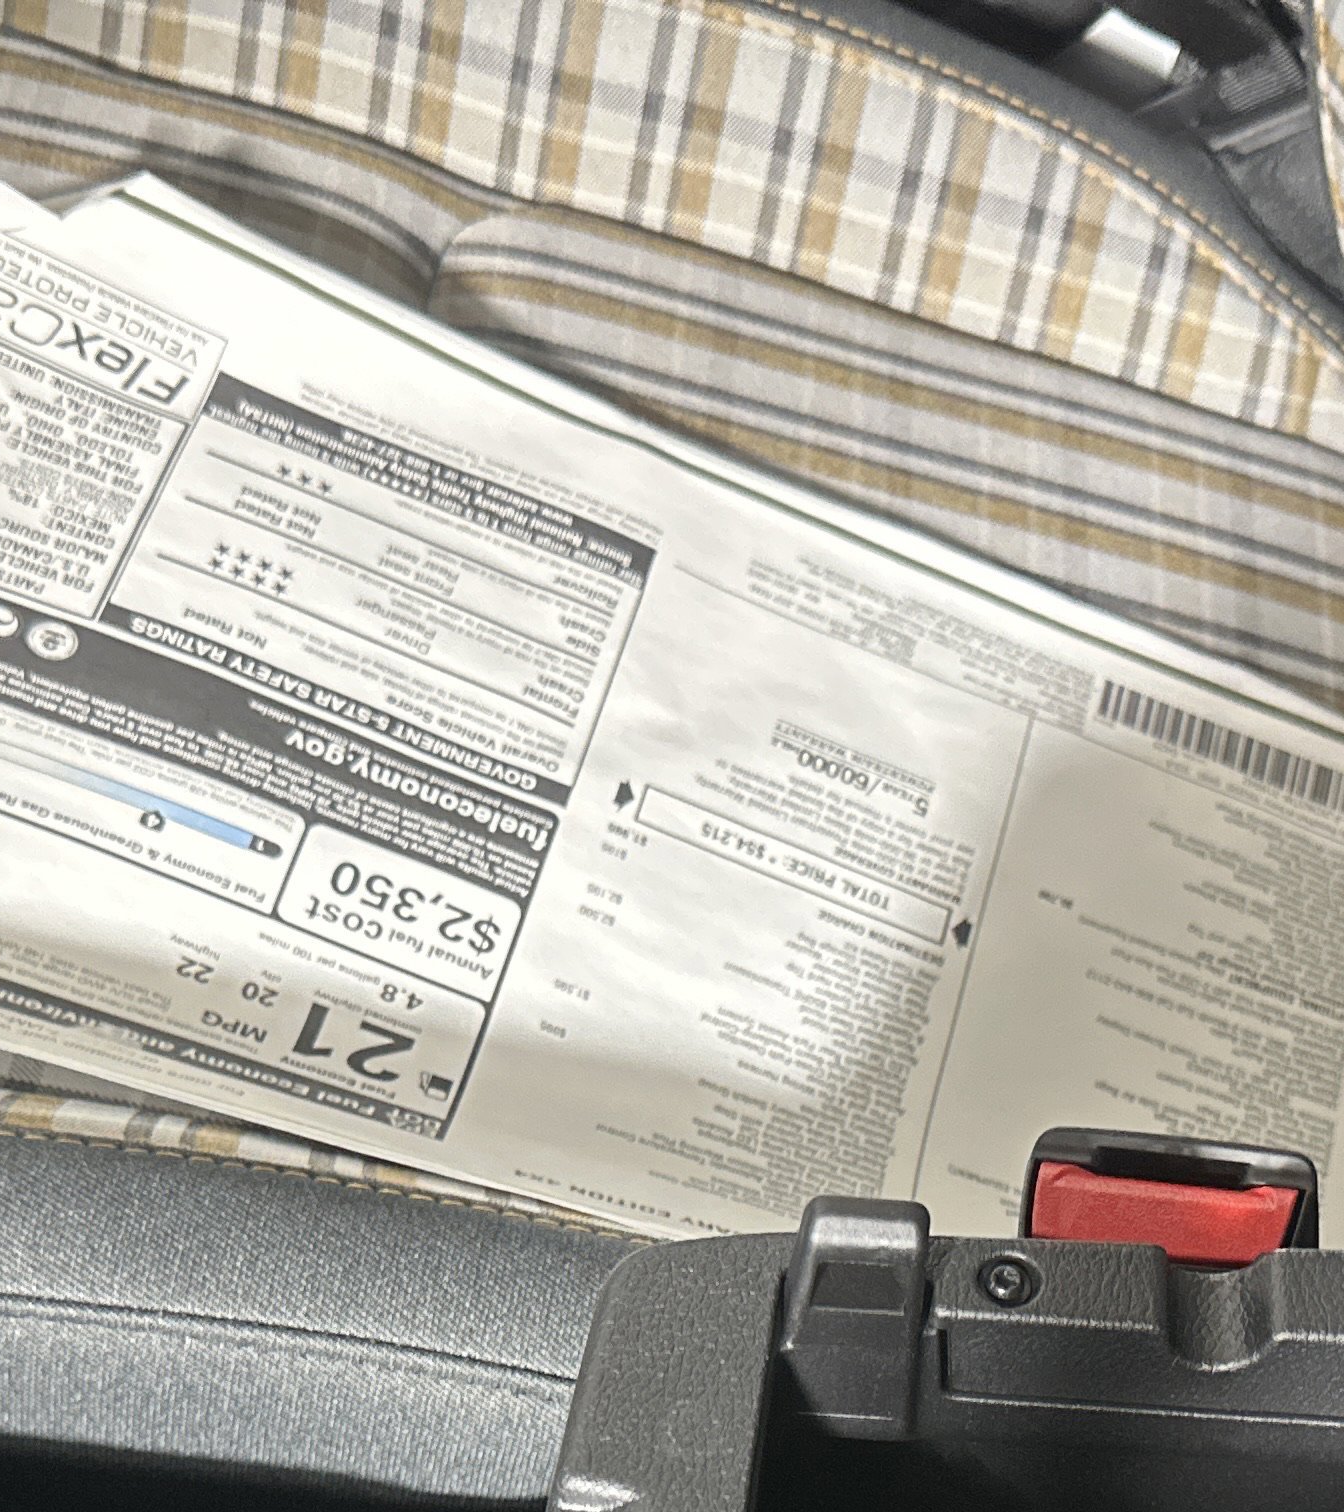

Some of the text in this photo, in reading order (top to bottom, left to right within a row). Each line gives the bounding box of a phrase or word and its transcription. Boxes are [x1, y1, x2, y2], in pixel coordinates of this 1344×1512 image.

[94, 304, 197, 364] VEHICLE
[54, 394, 97, 418] ITALY
[66, 411, 89, 430] OF
[13, 426, 92, 461] ASSEMBLY
[92, 423, 162, 455] COUNTRY
[71, 459, 109, 482] THIS
[99, 455, 139, 479] FINAL
[111, 475, 143, 494] FOR
[54, 538, 108, 564] MAJOR
[62, 573, 95, 593] FOR
[556, 614, 608, 644] Crash
[563, 633, 602, 658] Side
[384, 627, 579, 719] Frontal Driver
[129, 615, 538, 792] GOVERNMENT 5-STAR SAFETY RATINGS
[183, 607, 559, 773] Overall Vehicle Score Not Rated
[537, 674, 585, 703] Crash
[287, 732, 547, 850] fueleconomy.gov
[163, 854, 231, 890] Economy
[702, 822, 890, 910] TOTAL PRICE: $54,215
[234, 883, 266, 903] Fuel
[331, 863, 499, 953] $2,350
[307, 896, 493, 980] Annual fuel cost
[176, 956, 214, 985] 22
[241, 982, 279, 1007] 20
[380, 983, 423, 1010] 4.8
[201, 1010, 267, 1043] MPG
[294, 1004, 414, 1081] 21
[181, 1048, 309, 1095] Economy
[317, 1091, 376, 1116] Fuel
